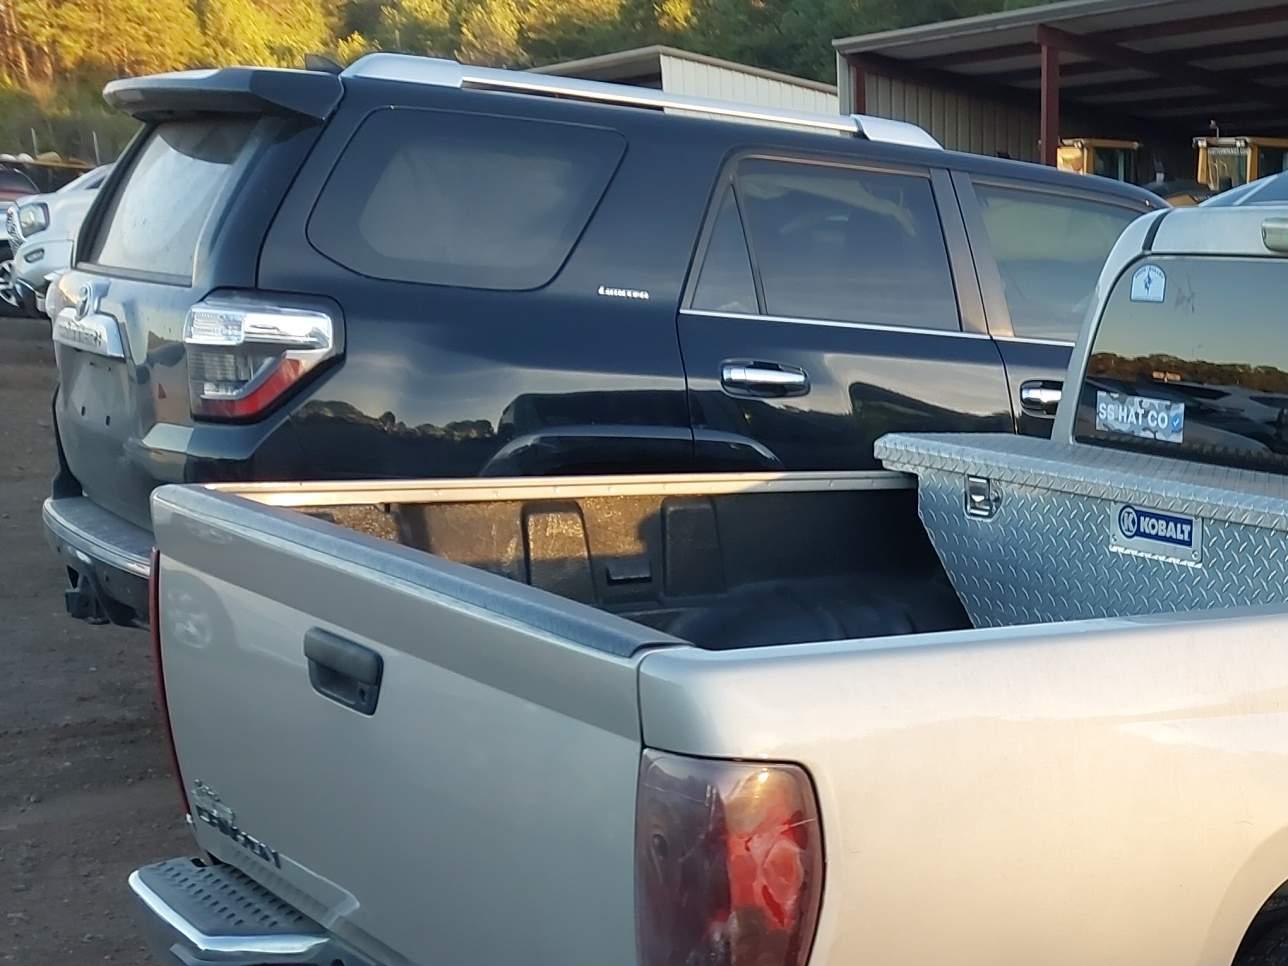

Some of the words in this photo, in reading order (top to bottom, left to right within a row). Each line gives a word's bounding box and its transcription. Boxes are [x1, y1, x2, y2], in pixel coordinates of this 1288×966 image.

[1118, 405, 1145, 426] HAT
[1147, 409, 1169, 429] CO
[1139, 515, 1192, 542] KOBALT
